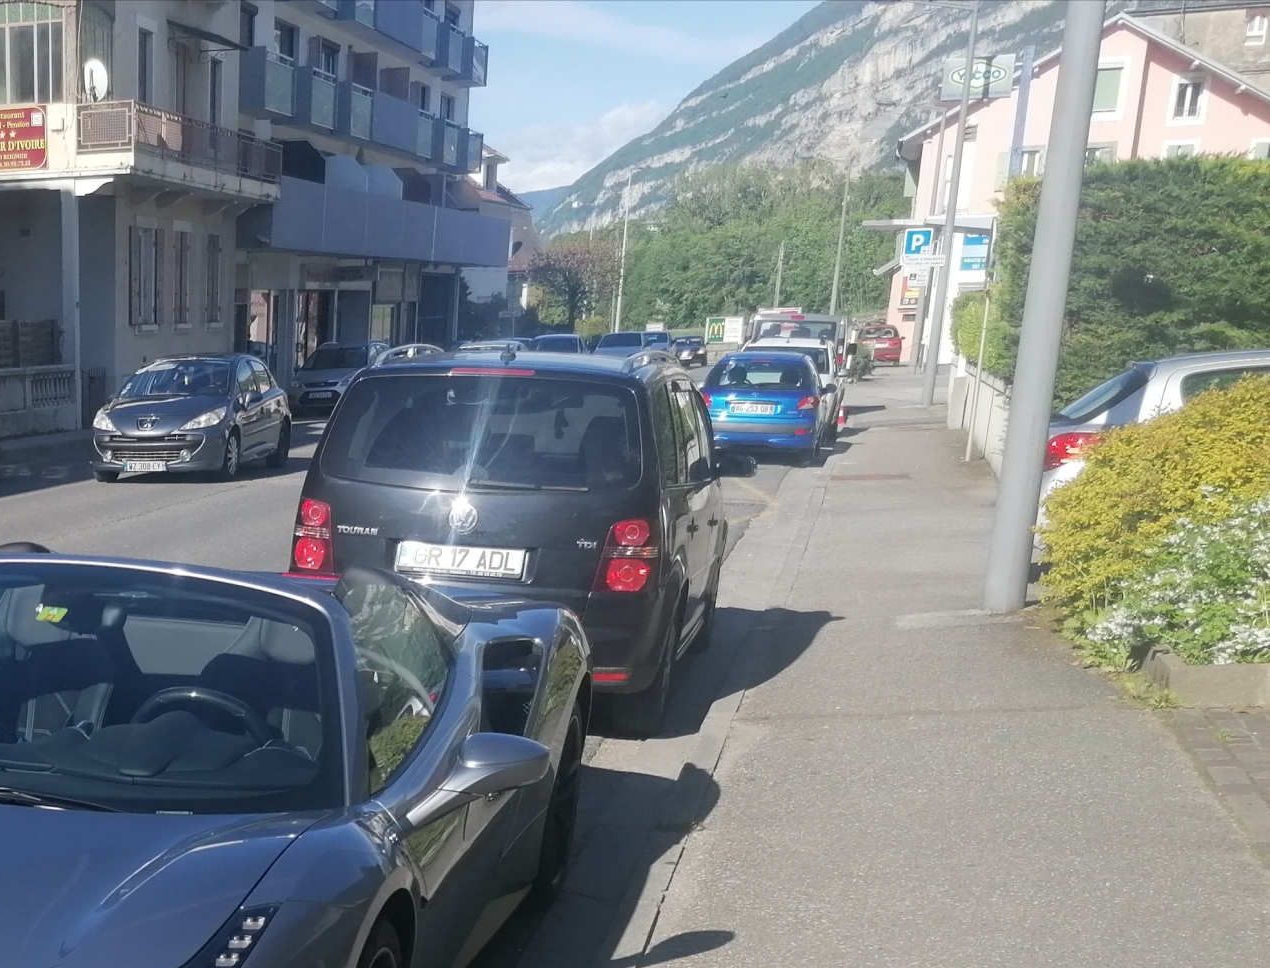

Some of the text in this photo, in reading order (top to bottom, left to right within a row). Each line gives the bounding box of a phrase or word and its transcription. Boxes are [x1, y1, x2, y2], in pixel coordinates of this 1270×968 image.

[7, 121, 30, 129] Pension
[8, 138, 45, 151] D'IVOIRE
[911, 234, 925, 251] P
[337, 524, 379, 536] TOURAN
[414, 546, 515, 572] GR 17 ADL
